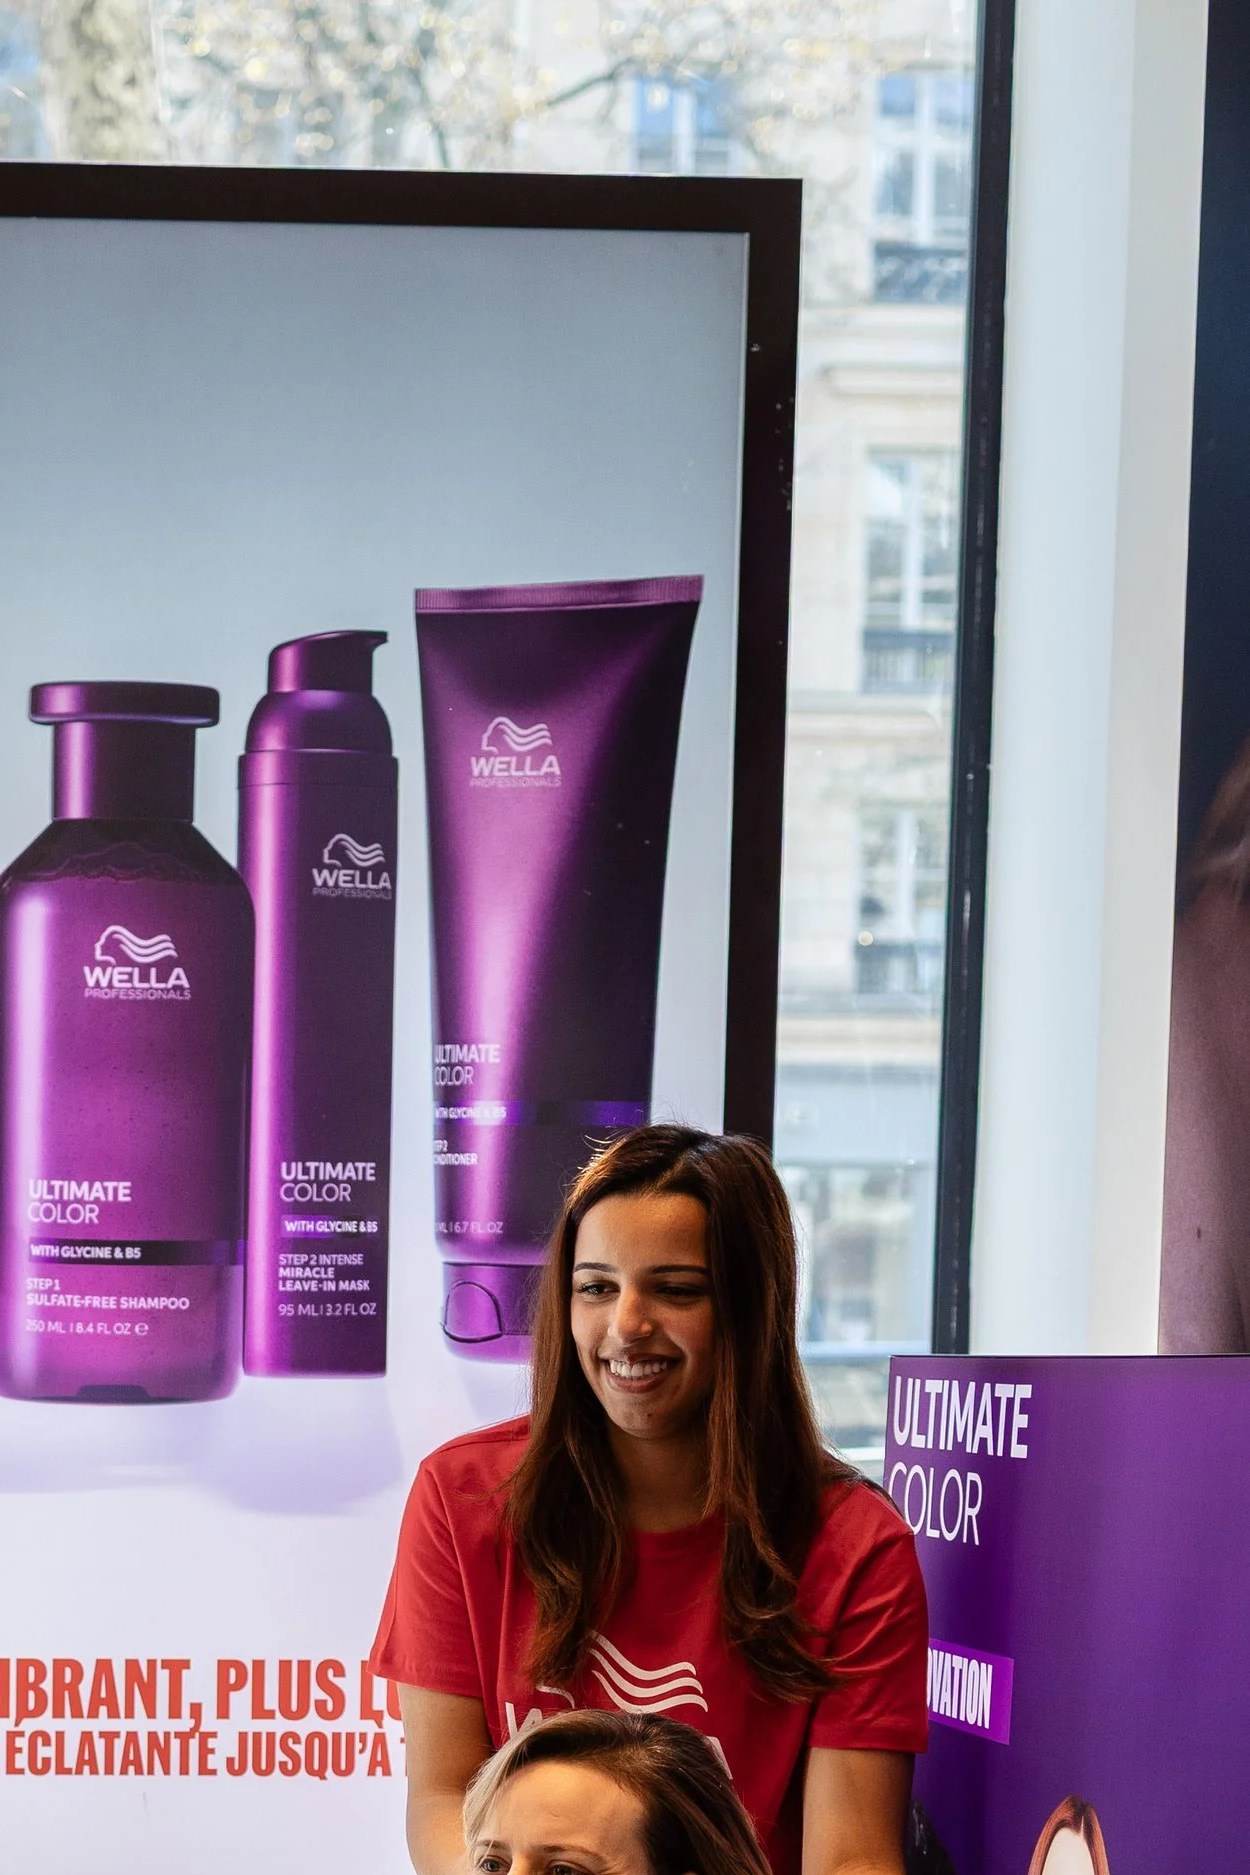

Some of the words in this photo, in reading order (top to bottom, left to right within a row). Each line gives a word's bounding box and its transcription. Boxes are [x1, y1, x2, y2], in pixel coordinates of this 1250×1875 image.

[470, 755, 561, 777] WELLA
[469, 775, 562, 788] PROFESSIONALS
[312, 868, 392, 890] WELLA
[83, 966, 190, 989] WELLA
[84, 988, 191, 1000] PROFESSIONALS
[435, 1044, 501, 1063] ULTIMATE
[434, 1065, 474, 1086] COLOR
[281, 1162, 376, 1181] ULTIMATE
[28, 1179, 132, 1201] ULTIMATE
[279, 1183, 352, 1202] COLOR
[27, 1202, 99, 1224] COLOR
[284, 1220, 314, 1232] WITH
[315, 1220, 358, 1233] GLYCINE
[487, 1221, 504, 1234] OZ
[30, 1244, 59, 1257] WITH
[61, 1246, 112, 1259] GLYCINE
[113, 1247, 123, 1259] &
[125, 1247, 141, 1259] B5
[278, 1254, 308, 1265] STEP
[309, 1254, 317, 1265] 2
[319, 1253, 364, 1265] INTENSE
[278, 1267, 335, 1278] MIRACLE
[26, 1278, 52, 1290] STEP
[278, 1280, 336, 1291] LEAVE-IN
[338, 1280, 370, 1291] MASK
[26, 1293, 117, 1309] SULFATE-FREE
[120, 1297, 190, 1309] SHAMPOO
[278, 1304, 295, 1316] 95
[298, 1304, 319, 1316] ML
[326, 1304, 342, 1316] 3.2
[344, 1303, 358, 1315] FL
[359, 1303, 377, 1315] OZ
[25, 1318, 45, 1332] 250
[47, 1321, 66, 1333] ML
[76, 1322, 94, 1333] 8.4
[97, 1322, 111, 1334] FL
[113, 1322, 131, 1335] OZ
[893, 1376, 1032, 1459] ULTIMATE
[216, 1658, 346, 1722] PLUS
[6, 1716, 217, 1776] ÉCLATANTE
